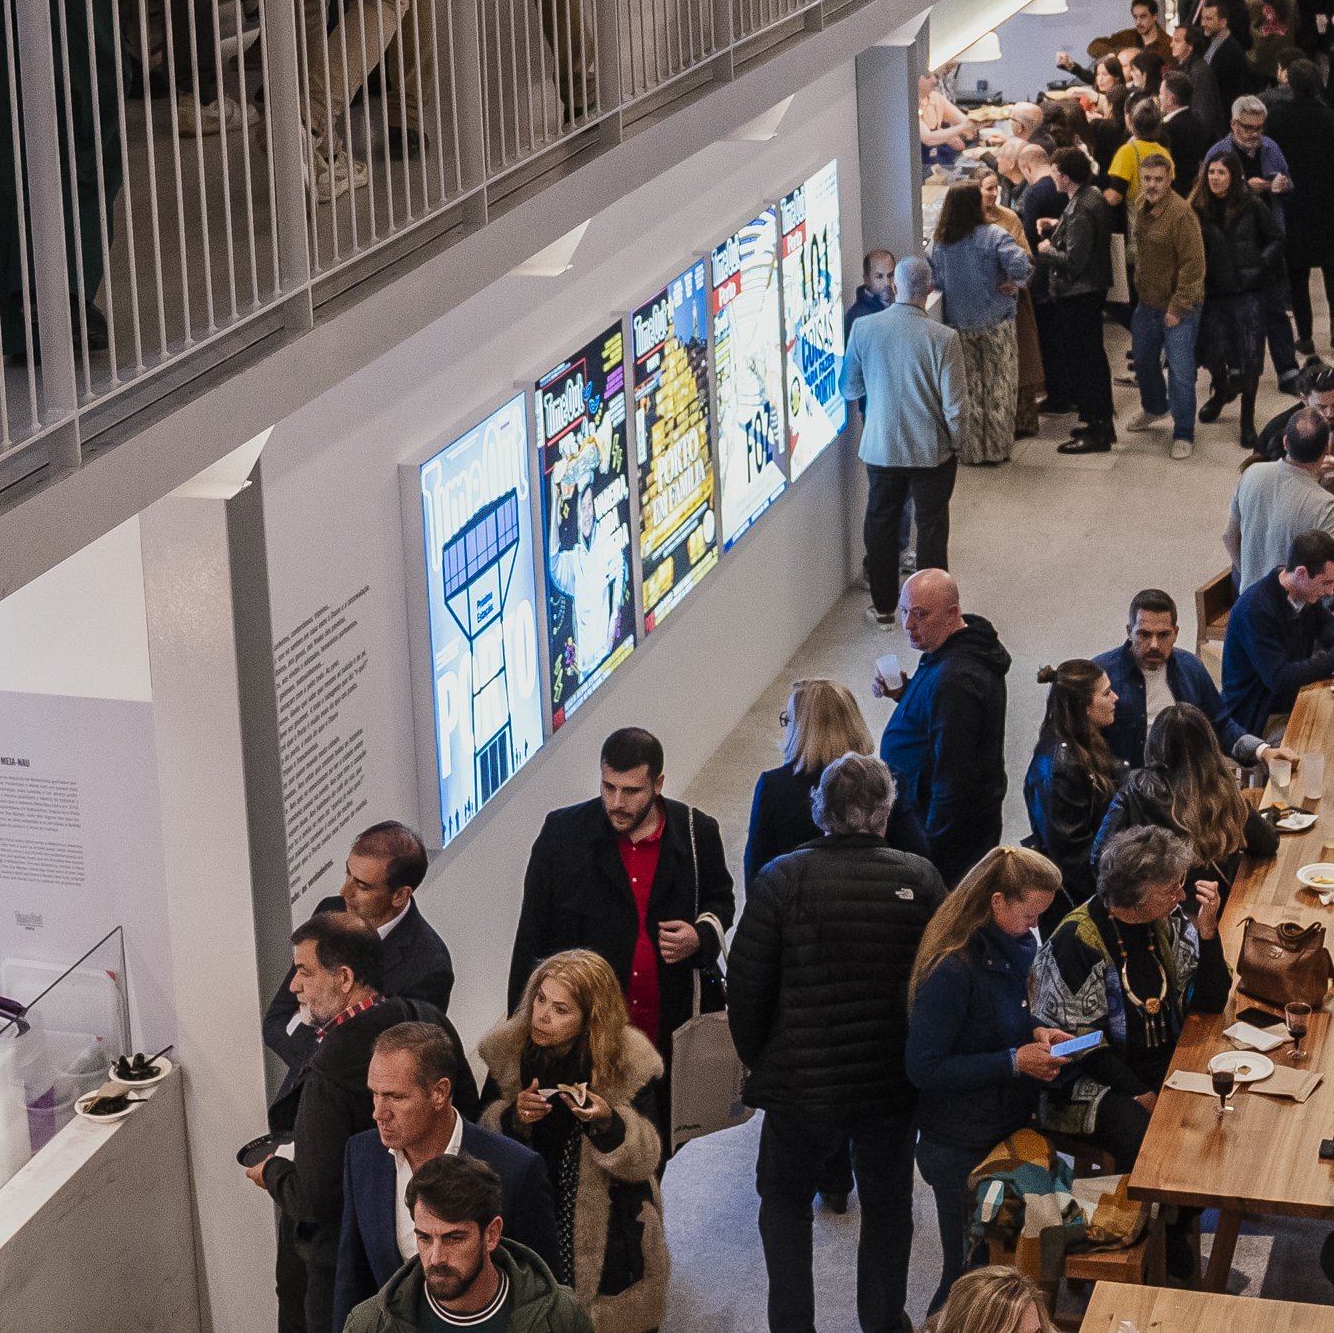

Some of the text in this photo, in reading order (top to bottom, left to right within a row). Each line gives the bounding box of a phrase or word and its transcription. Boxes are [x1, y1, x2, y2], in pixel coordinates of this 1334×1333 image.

[801, 225, 831, 304] 101
[718, 281, 736, 308] Porto
[656, 427, 700, 493] PORTO
[0, 756, 30, 768] MEIA-NAU
